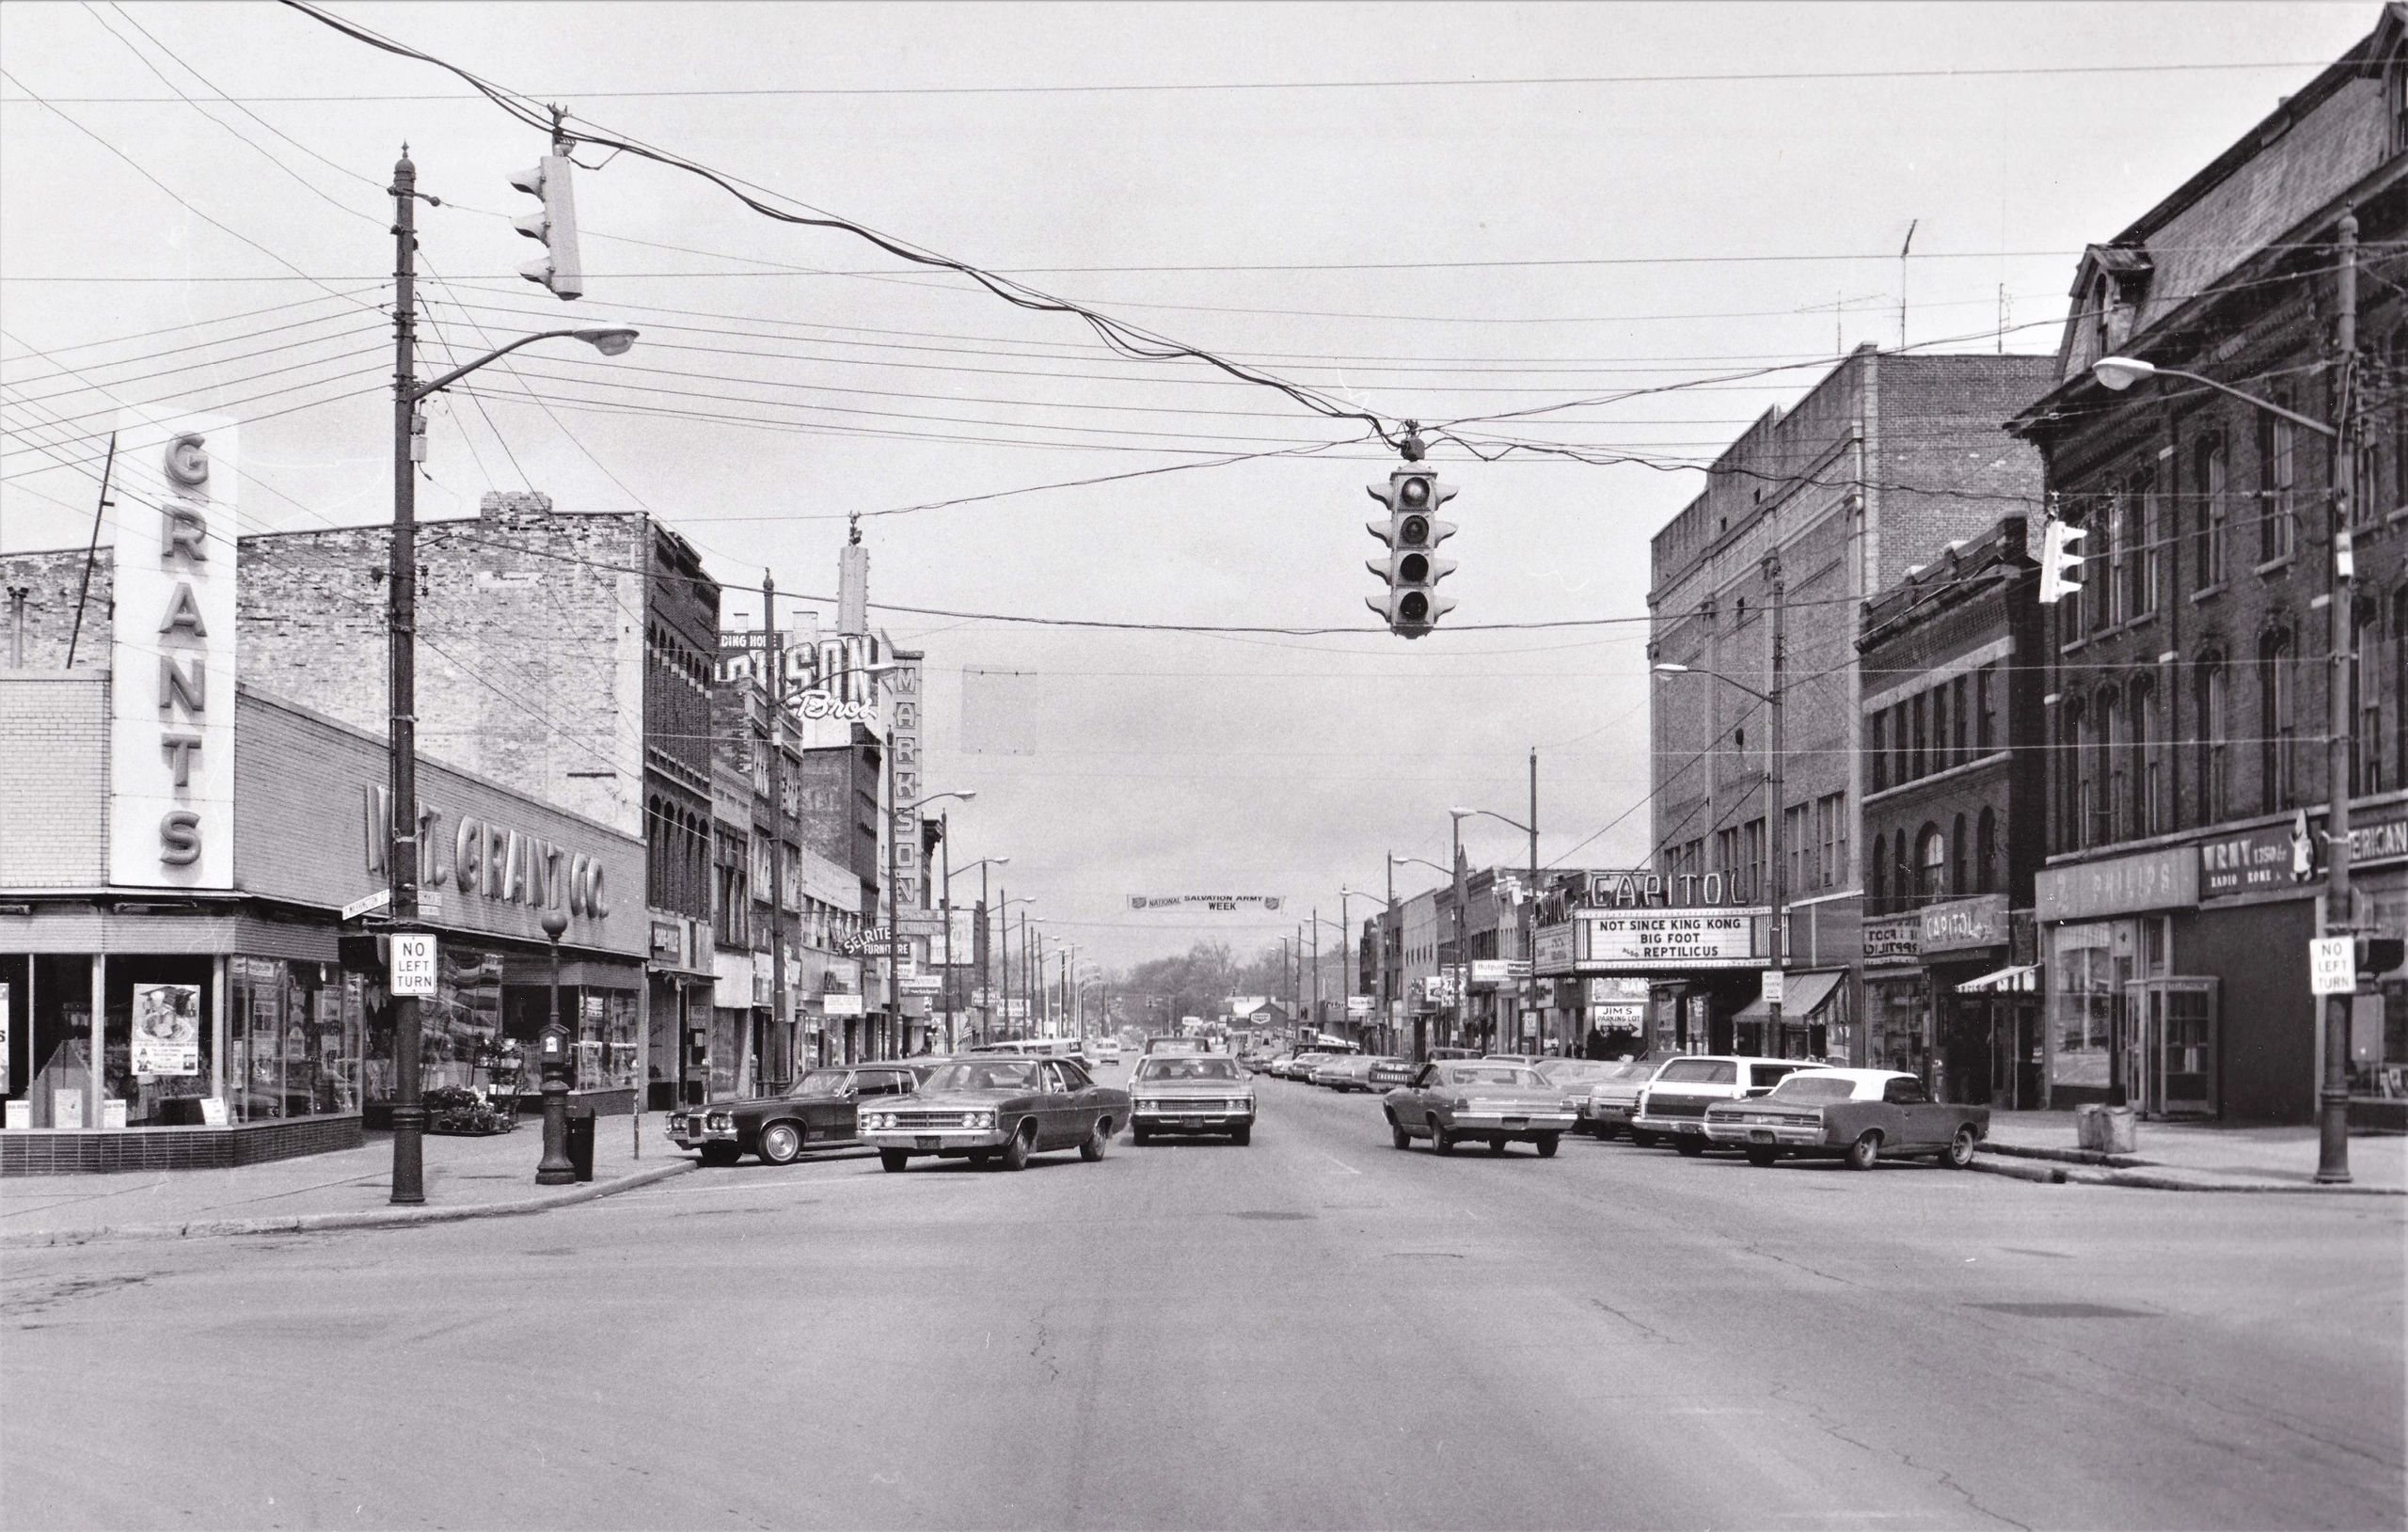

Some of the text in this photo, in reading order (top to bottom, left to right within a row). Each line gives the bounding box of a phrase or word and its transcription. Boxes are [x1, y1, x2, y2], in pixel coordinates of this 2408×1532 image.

[158, 431, 209, 866] GRANTS
[798, 689, 878, 719] Bros
[895, 668, 916, 903] MARKSON
[2349, 820, 2408, 860] ERICAN
[456, 813, 564, 911] GRANT
[2210, 874, 2238, 889] RADIO
[2247, 869, 2272, 884] ROME
[1592, 873, 1747, 908] CAPITOL
[1149, 896, 1181, 908] NATIONAL
[1236, 894, 1263, 903] ARMY
[1209, 902, 1237, 911] WEEK
[1599, 918, 1741, 931] NOT SINCE KING KONG
[1926, 911, 1973, 941] CAPITOL
[844, 925, 891, 955] SELRITE
[1640, 933, 1701, 944] BIG FOOT
[403, 941, 425, 956] NO
[863, 943, 909, 956] FURNITRE
[1622, 945, 1719, 958] ALSO REPTILICUS
[2321, 941, 2343, 956] NO
[398, 960, 430, 972] LEFT
[2318, 959, 2348, 973] LEFT
[396, 975, 433, 988] TURN
[2318, 975, 2350, 989] TURN
[1376, 1072, 1408, 1082] CHEVROLET
